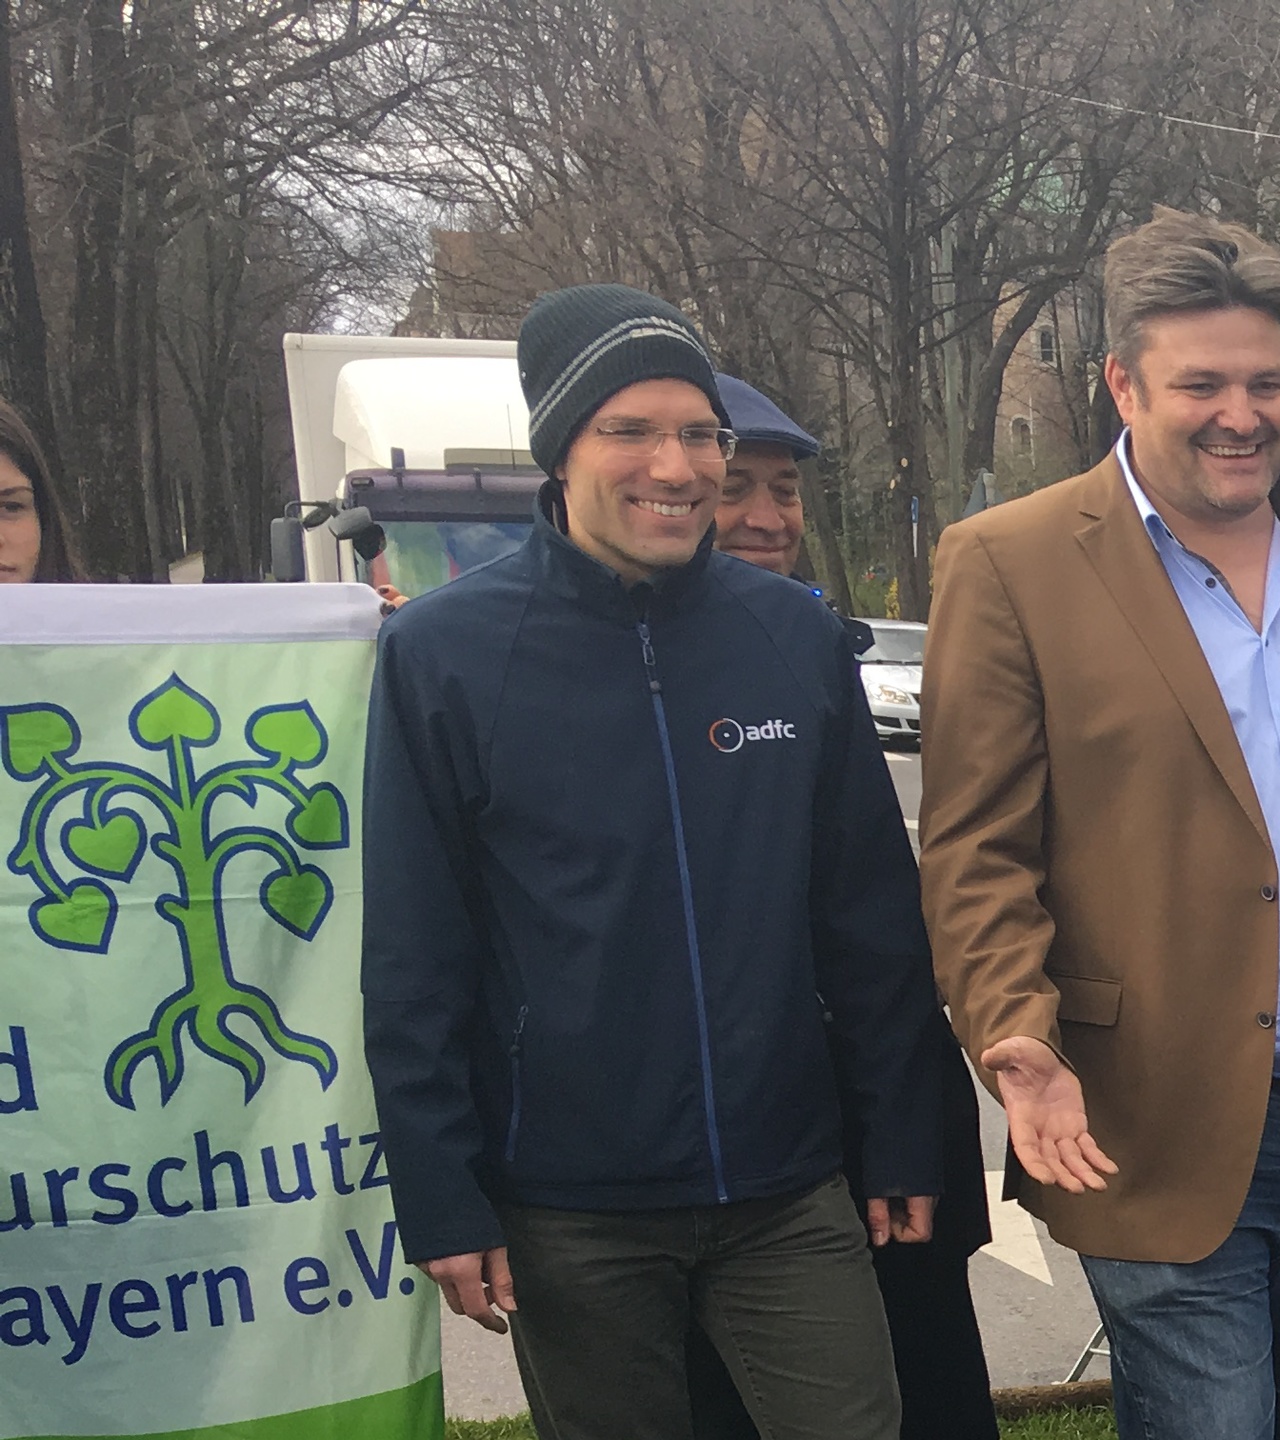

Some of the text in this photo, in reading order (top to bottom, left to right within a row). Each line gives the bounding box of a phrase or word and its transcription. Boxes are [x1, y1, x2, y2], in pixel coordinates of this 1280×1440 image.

[745, 719, 797, 741] adfc
[0, 1221, 415, 1366] ayern e.V.
